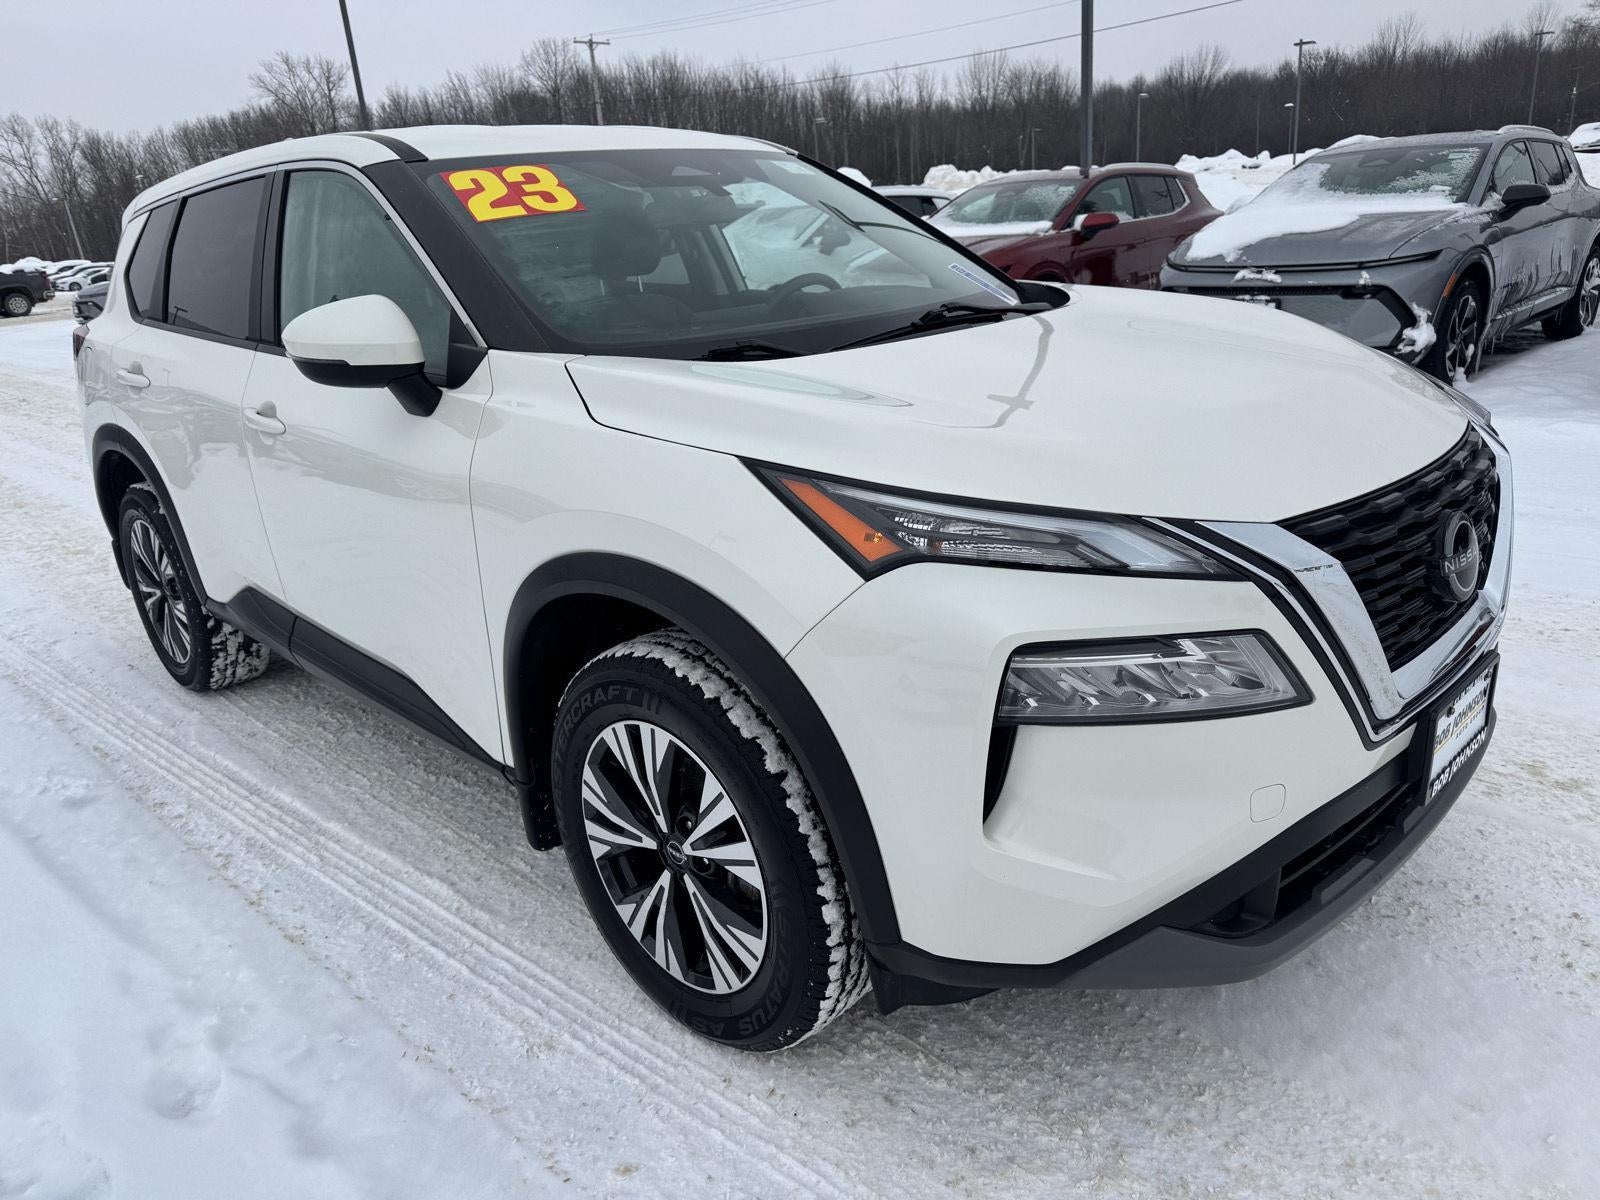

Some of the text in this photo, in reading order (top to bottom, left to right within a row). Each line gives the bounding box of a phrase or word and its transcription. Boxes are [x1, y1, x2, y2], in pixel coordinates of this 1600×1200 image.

[448, 165, 578, 221] 23
[1444, 546, 1478, 574] NISSA
[1431, 767, 1450, 798] BOB
[1448, 727, 1488, 782] JOHNSON
